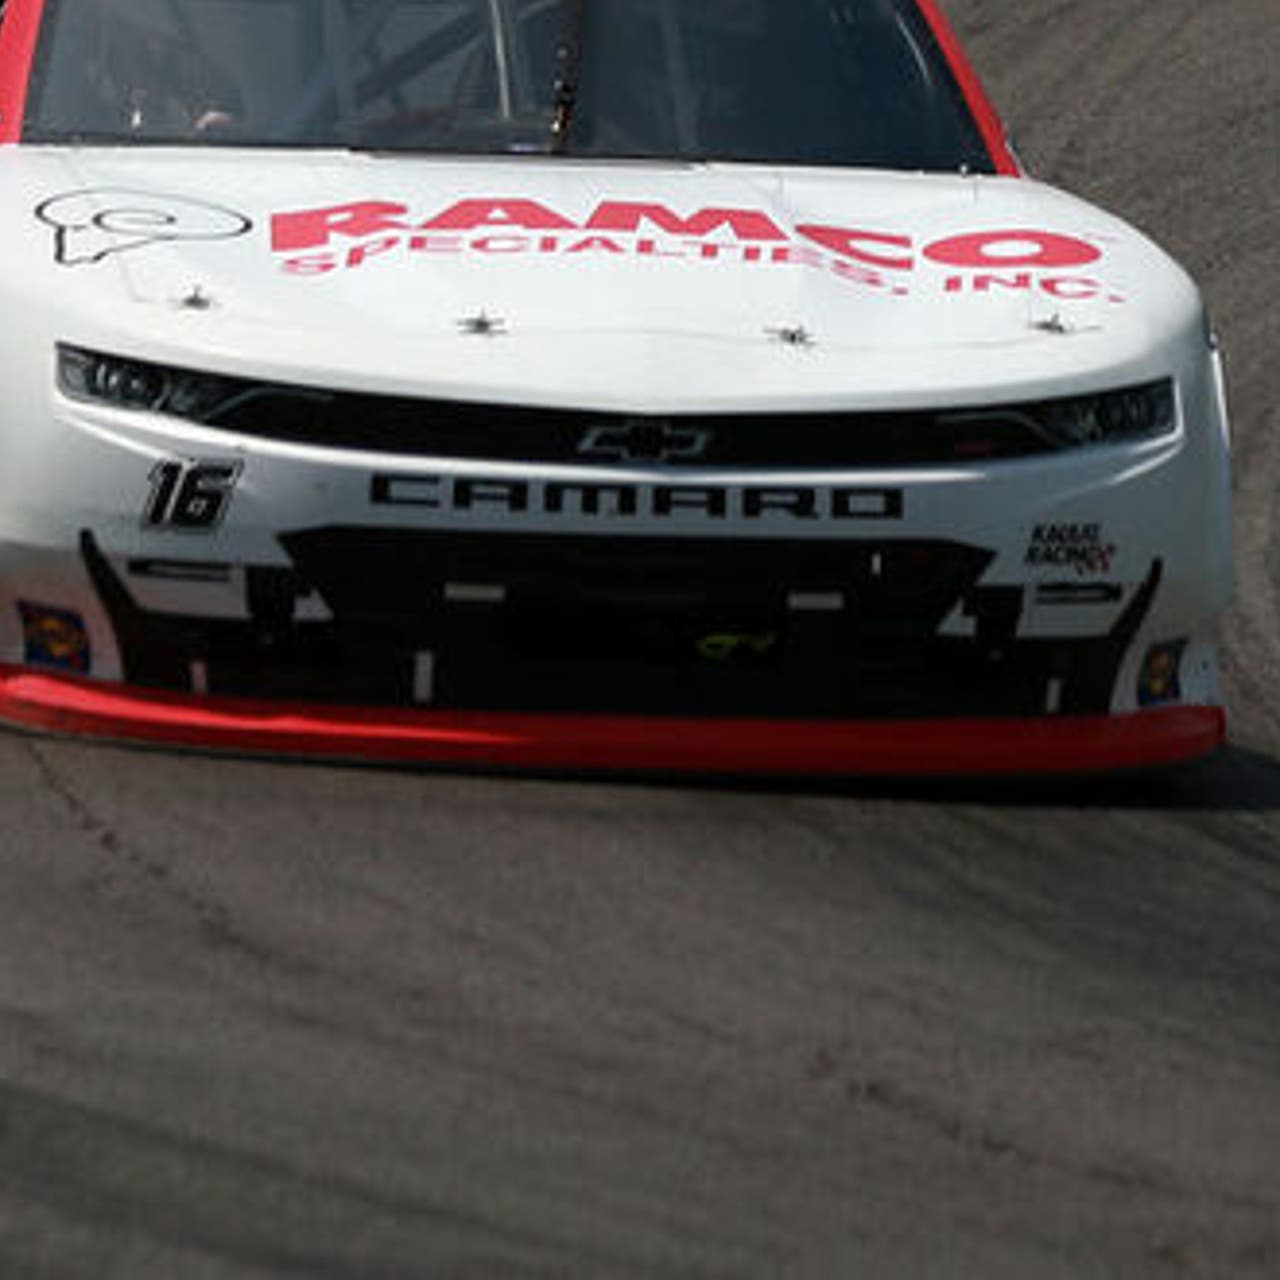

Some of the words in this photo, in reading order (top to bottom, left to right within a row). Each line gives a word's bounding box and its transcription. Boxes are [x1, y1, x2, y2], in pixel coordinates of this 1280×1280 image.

[269, 196, 1105, 271] RAMCO
[942, 272, 1126, 304] INC.
[140, 456, 244, 530] 16
[369, 471, 904, 521] CAMARO
